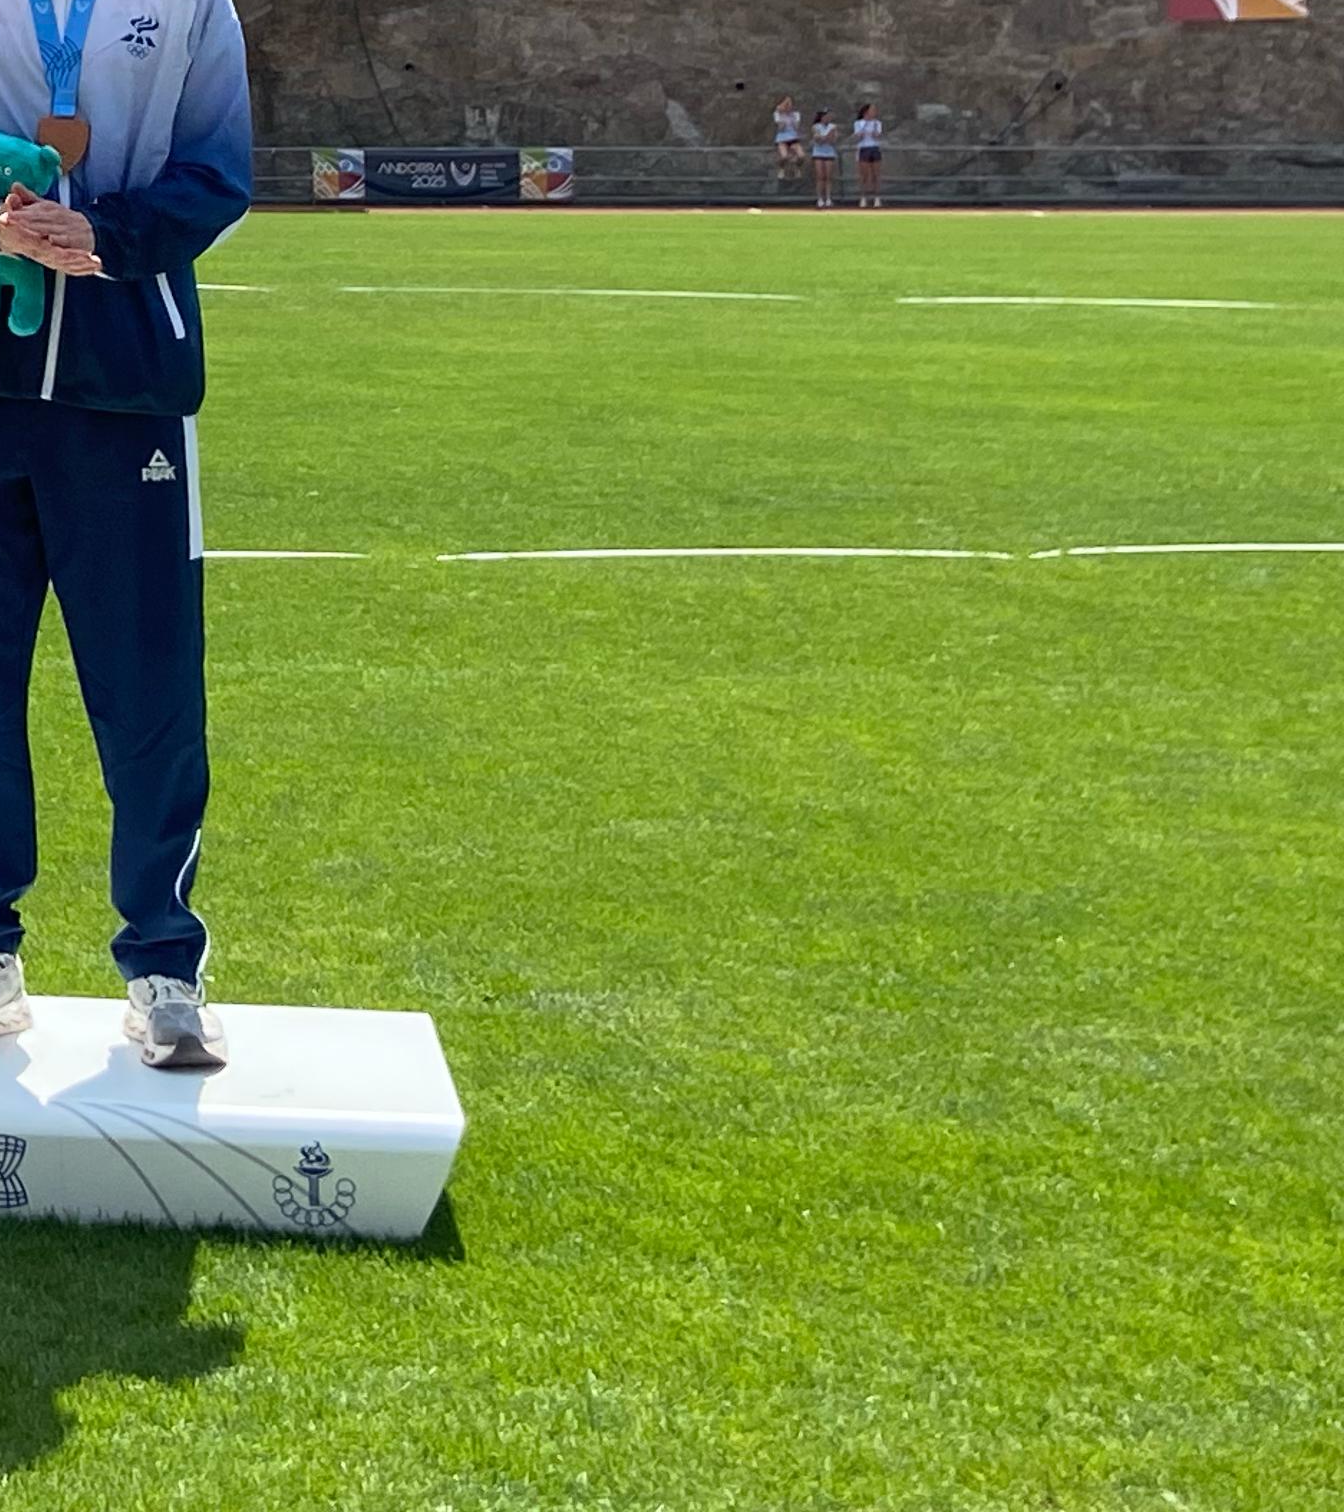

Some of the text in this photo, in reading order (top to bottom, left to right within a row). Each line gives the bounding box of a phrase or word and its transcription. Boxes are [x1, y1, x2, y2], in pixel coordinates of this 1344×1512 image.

[377, 162, 446, 174] ANDORRA
[412, 175, 447, 188] 2025
[141, 466, 177, 481] PEAK
